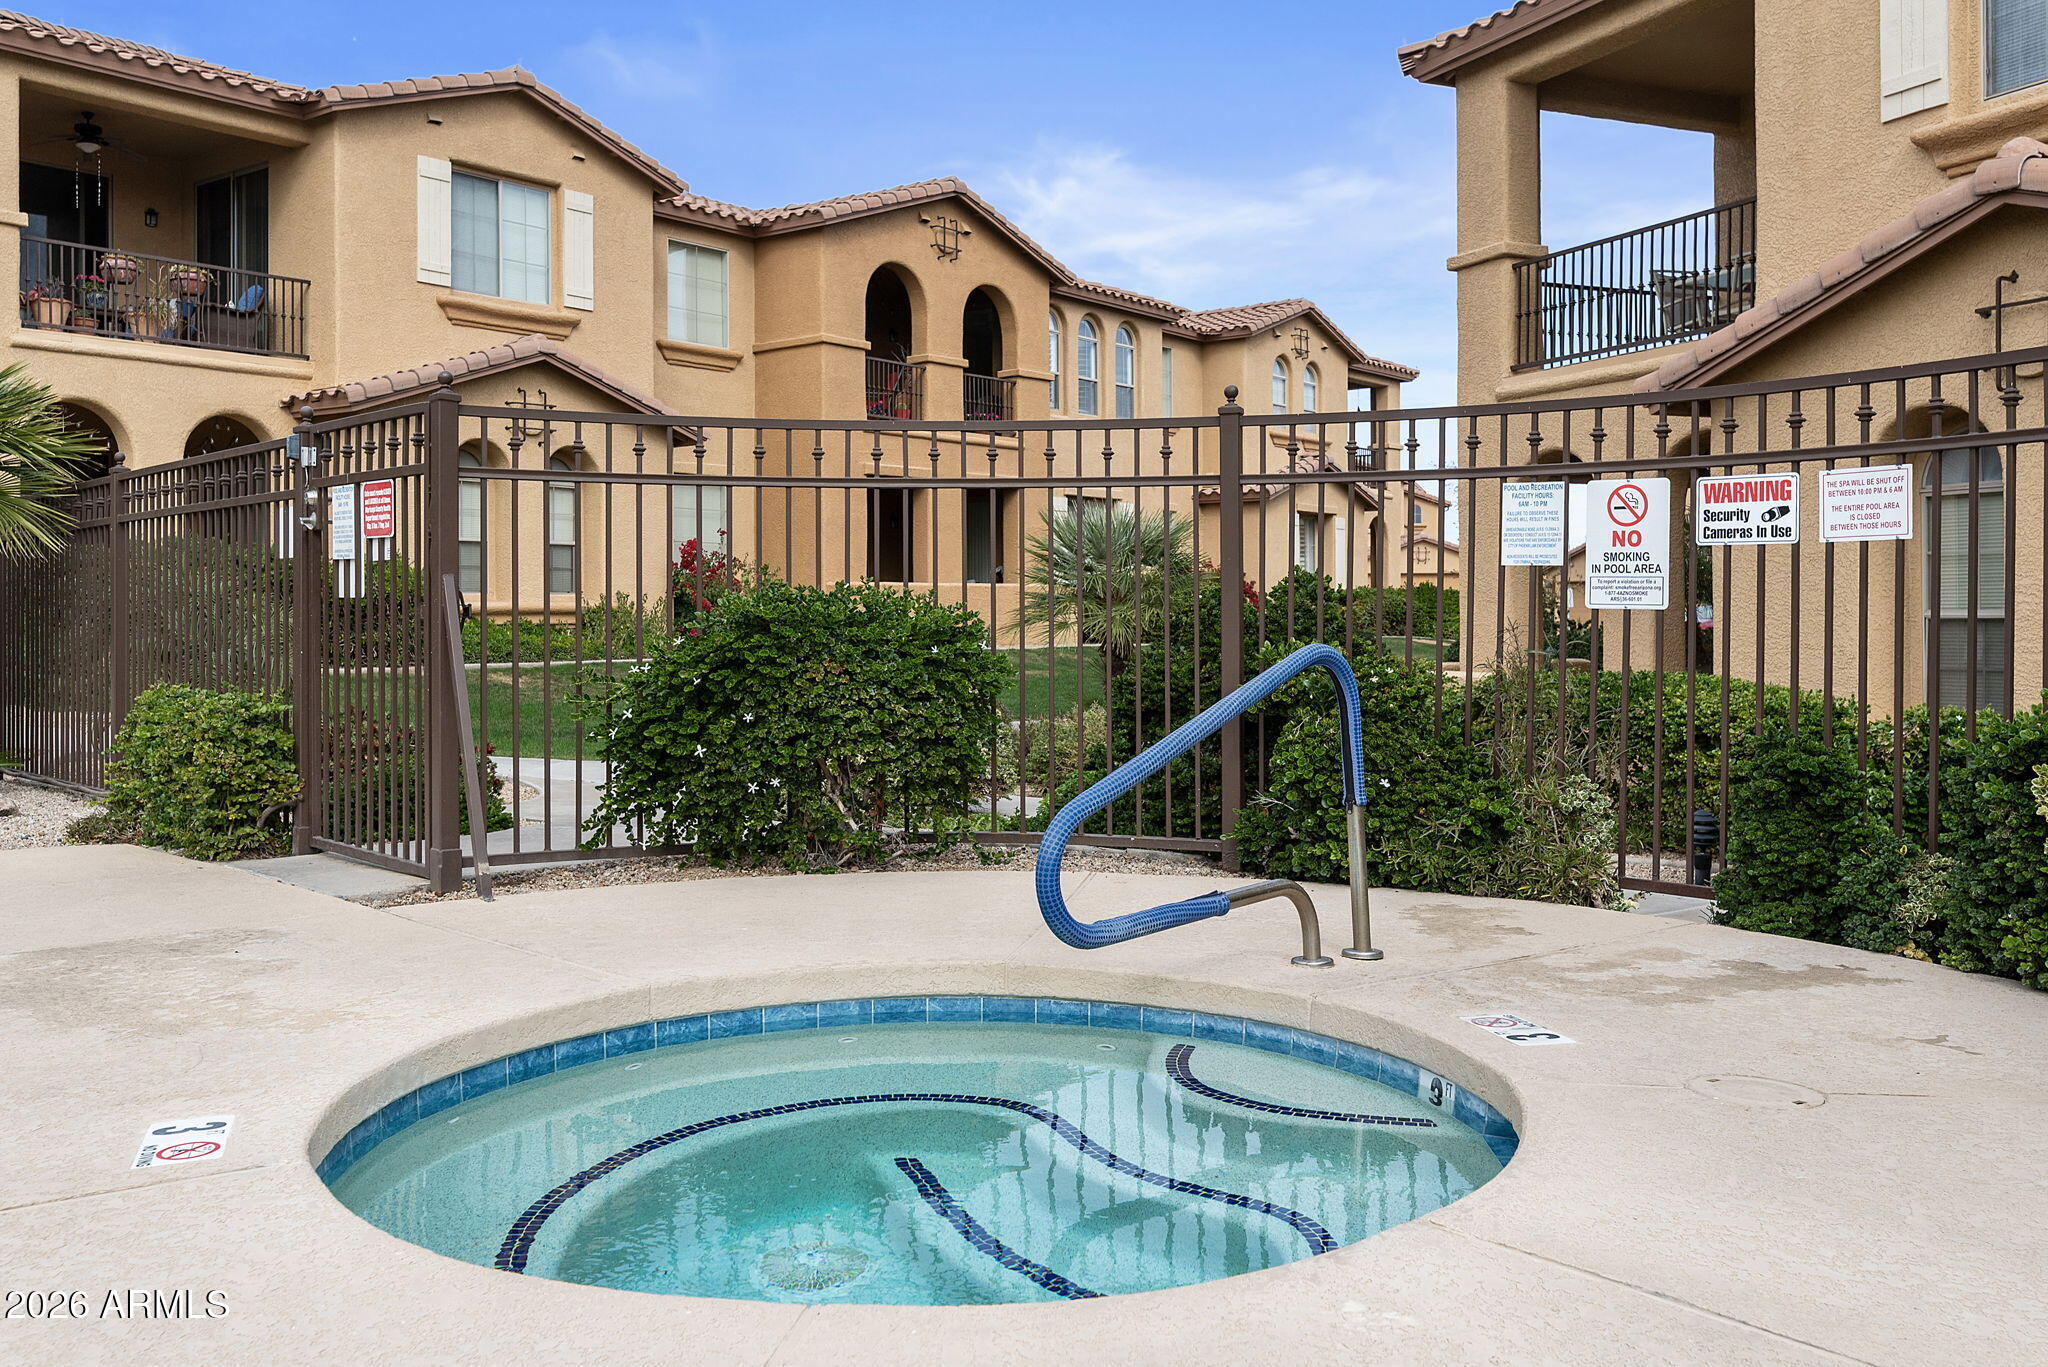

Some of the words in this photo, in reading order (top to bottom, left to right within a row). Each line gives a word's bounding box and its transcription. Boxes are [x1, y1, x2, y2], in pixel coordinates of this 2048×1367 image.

[1876, 477, 1891, 485] SHUT
[1893, 476, 1905, 484] OFF
[1703, 479, 1792, 504] WARNING
[1828, 489, 1856, 497] BETWEEN
[1844, 504, 1864, 512] ENTIRE
[1866, 503, 1882, 511] POOL
[1703, 508, 1750, 523] Security
[1859, 522, 1879, 530] THOSE
[1880, 521, 1902, 529] HOURS
[1703, 526, 1753, 539] Cameras
[1756, 525, 1767, 538] In
[1770, 524, 1792, 538] Use
[1612, 530, 1642, 547] NO
[1603, 552, 1650, 561] SMOKING
[1591, 564, 1601, 573] IN
[1604, 564, 1631, 573] POOL
[1634, 564, 1662, 573] AREA
[1446, 1082, 1453, 1098] FT
[152, 1122, 227, 1135] 3
